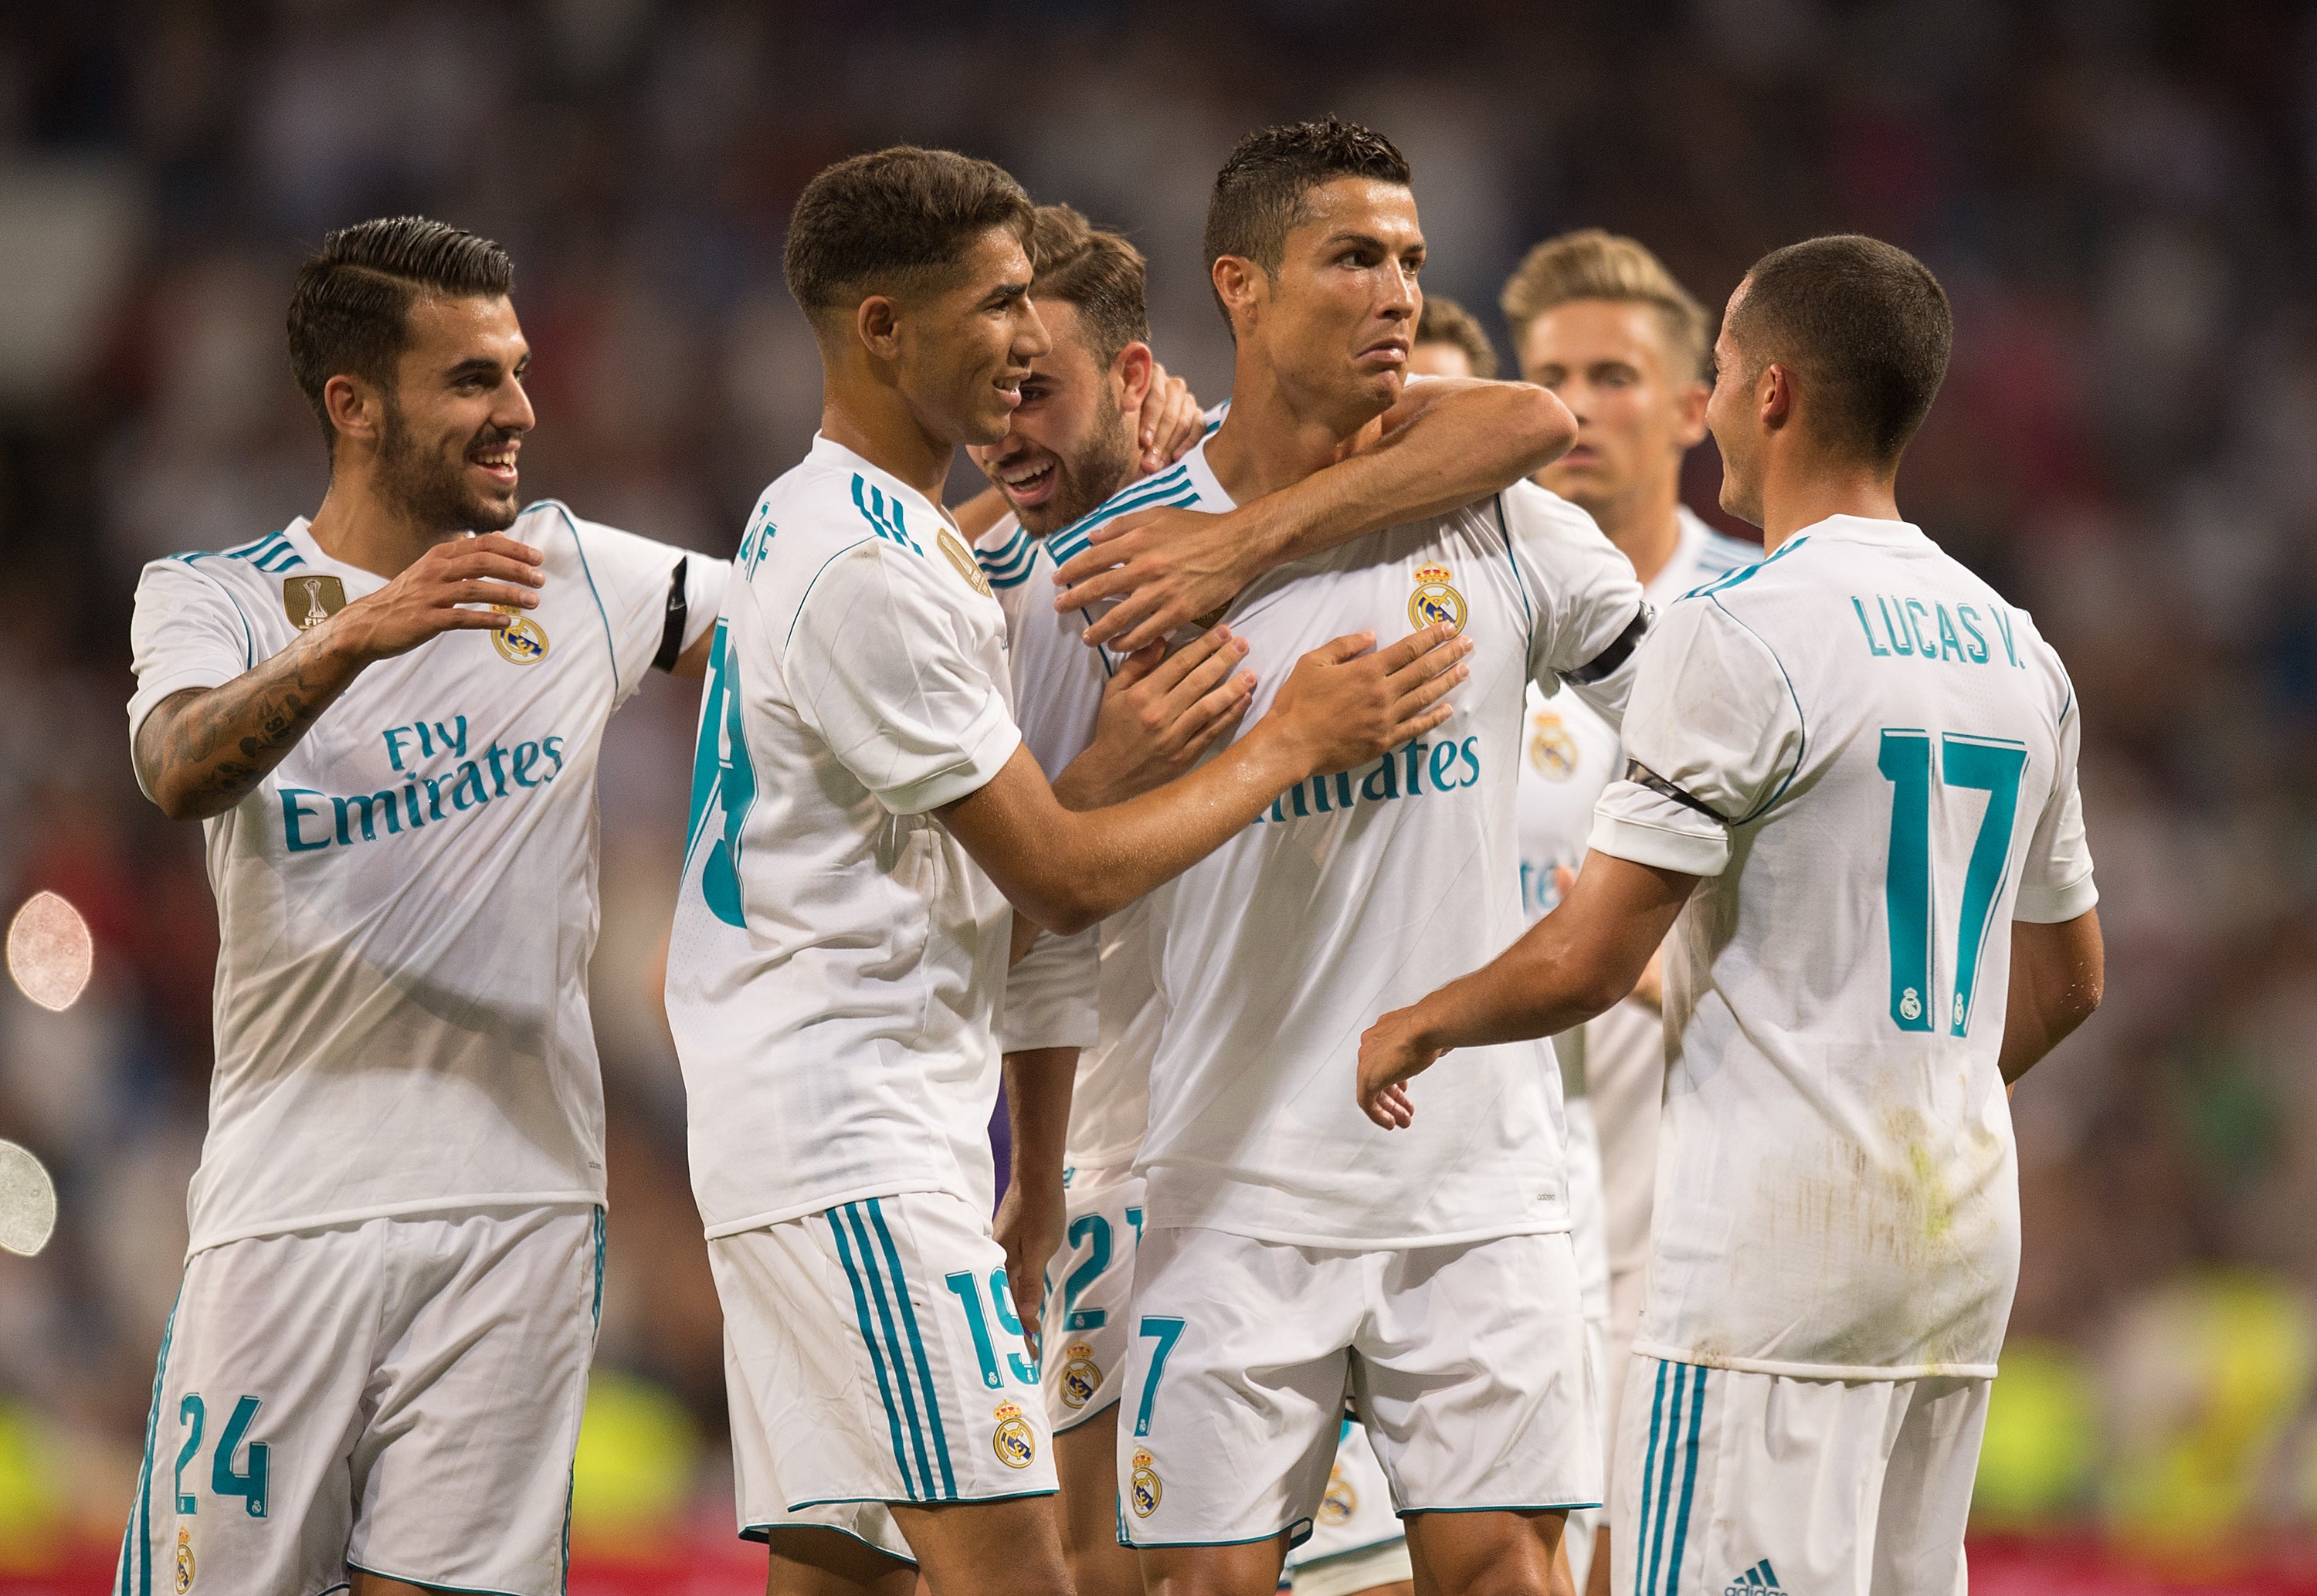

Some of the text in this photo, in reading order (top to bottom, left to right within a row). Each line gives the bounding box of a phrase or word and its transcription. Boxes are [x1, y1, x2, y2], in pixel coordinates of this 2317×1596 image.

[1851, 594, 2026, 670] LUCAS V.
[278, 735, 565, 852] Emirates
[382, 715, 467, 771] Fly
[1251, 735, 1481, 825] irates
[1878, 728, 2030, 1038] 17
[945, 1266, 1040, 1390] 19
[1134, 1314, 1187, 1437] 7
[175, 1392, 271, 1518] 24
[1725, 1585, 1789, 1596] adid
